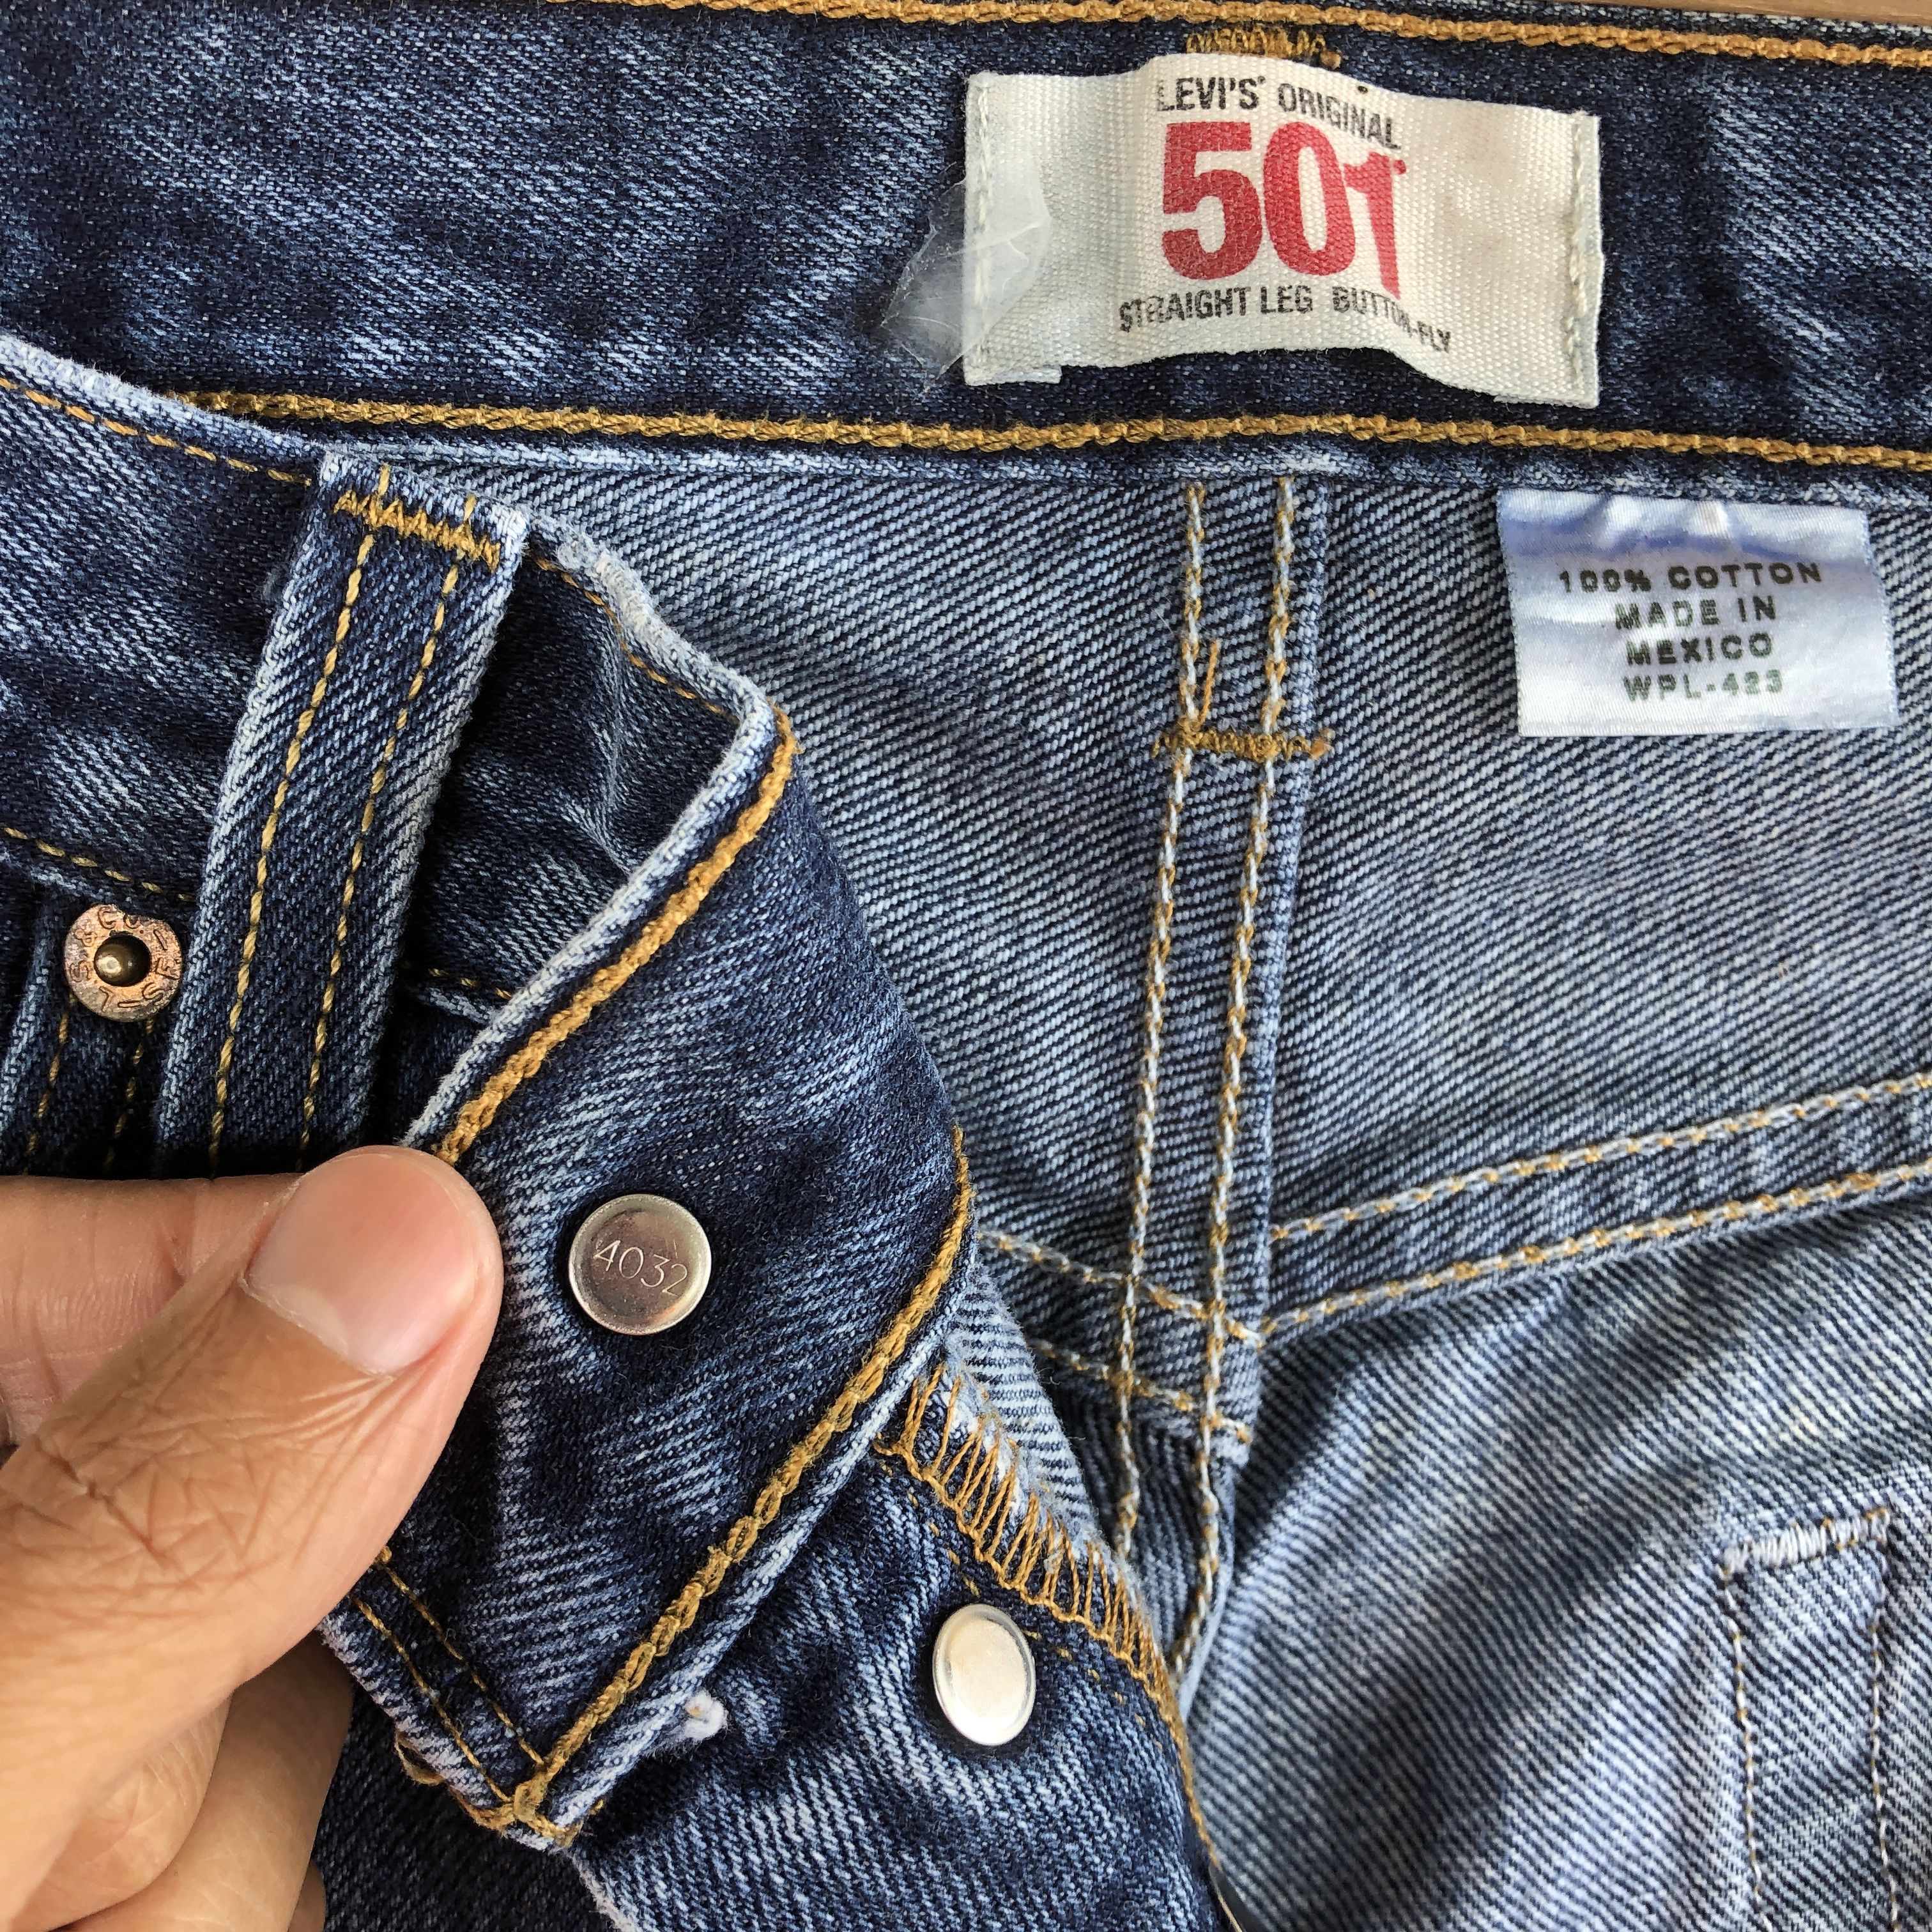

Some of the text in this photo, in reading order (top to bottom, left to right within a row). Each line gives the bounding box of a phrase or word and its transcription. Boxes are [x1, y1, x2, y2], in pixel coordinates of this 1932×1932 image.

[1157, 76, 1402, 149] LEVI'S ORIGINAL
[1162, 121, 1401, 300] 501
[1119, 285, 1451, 353] STRAIGHT LEG BUTTON-FLY
[1559, 562, 1821, 593] 100% COTTON
[1614, 595, 1776, 629] MADE IN
[1626, 632, 1773, 666] MEXICO
[1623, 669, 1783, 702] WPL-423
[594, 1239, 687, 1297] 4032
